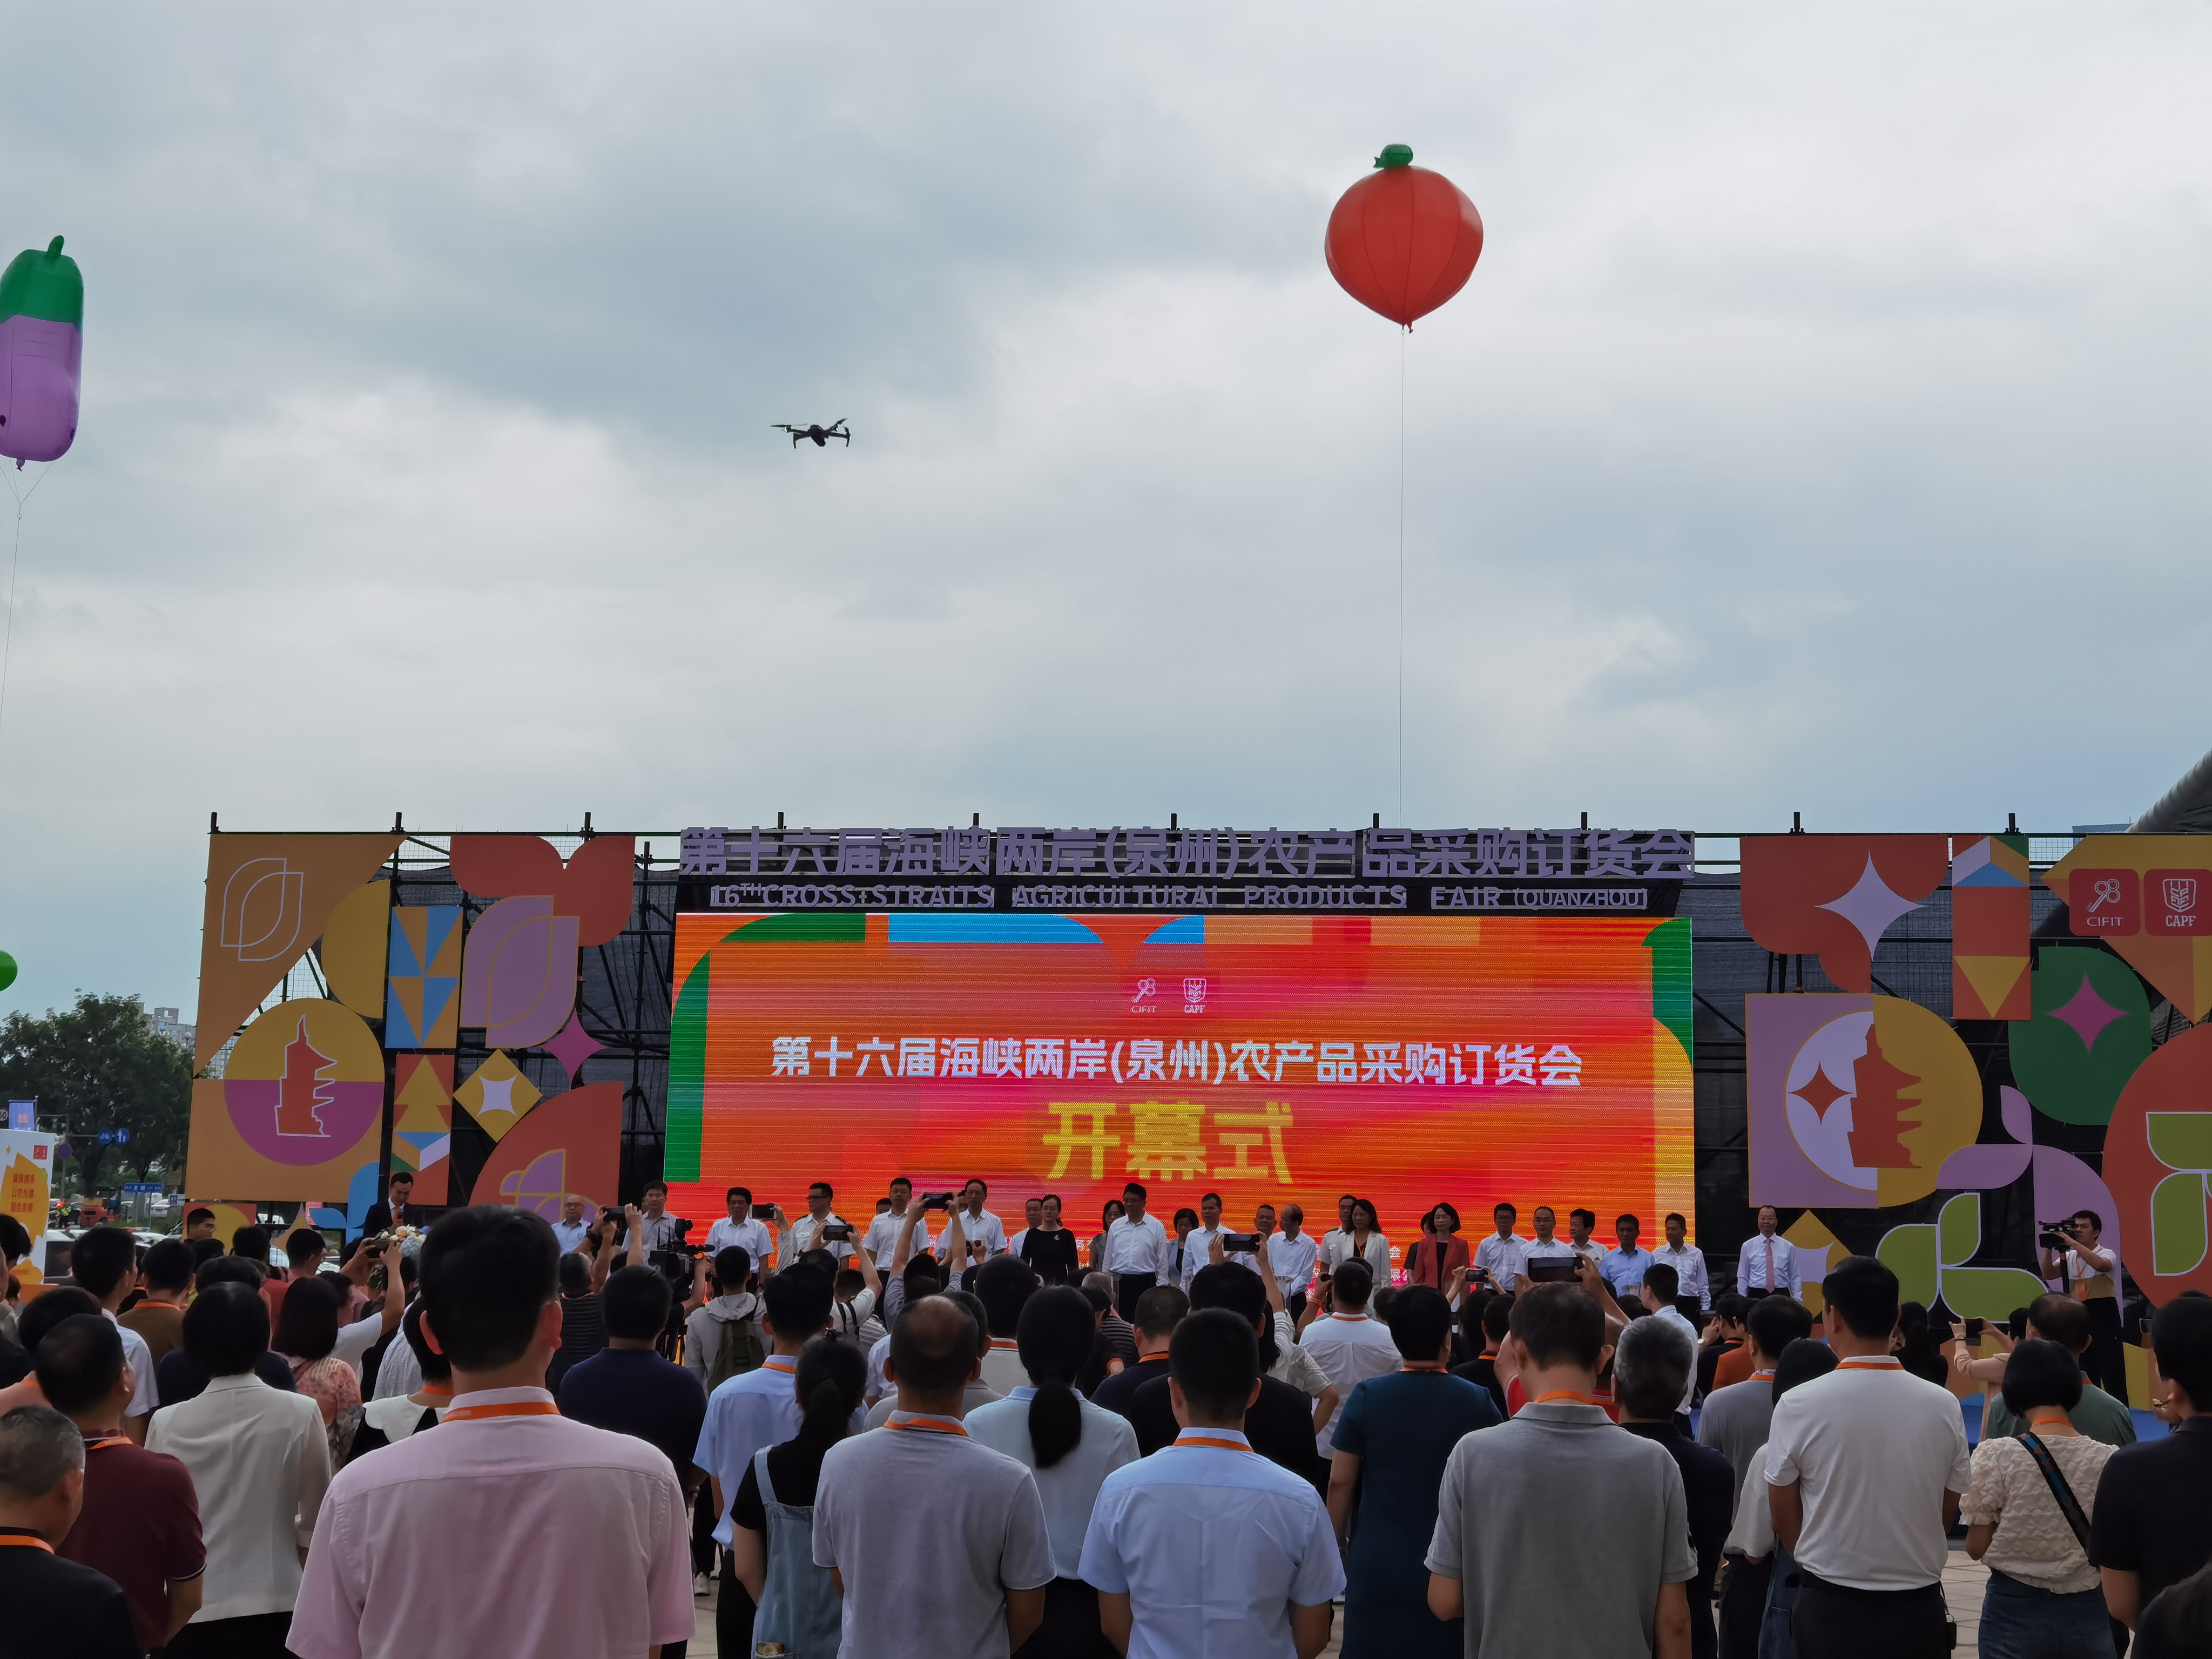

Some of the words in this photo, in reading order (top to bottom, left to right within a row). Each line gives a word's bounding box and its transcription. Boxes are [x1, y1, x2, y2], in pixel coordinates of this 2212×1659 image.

[680, 825, 1692, 879] 第十六届海峡两岸(泉州)农产品采购订货会
[1012, 885, 1225, 908] AGRICULTURAL
[1244, 885, 1406, 908] PRODUCTS
[1432, 886, 1501, 909] FAIR
[2086, 917, 2123, 927] CIFIT
[2166, 915, 2196, 927] CAPF
[1184, 1004, 1205, 1013] CAPF
[771, 1036, 1582, 1086] 第十六届海峡两岸(泉州)农产品采购订货会
[1043, 1101, 1293, 1183] 开幕式
